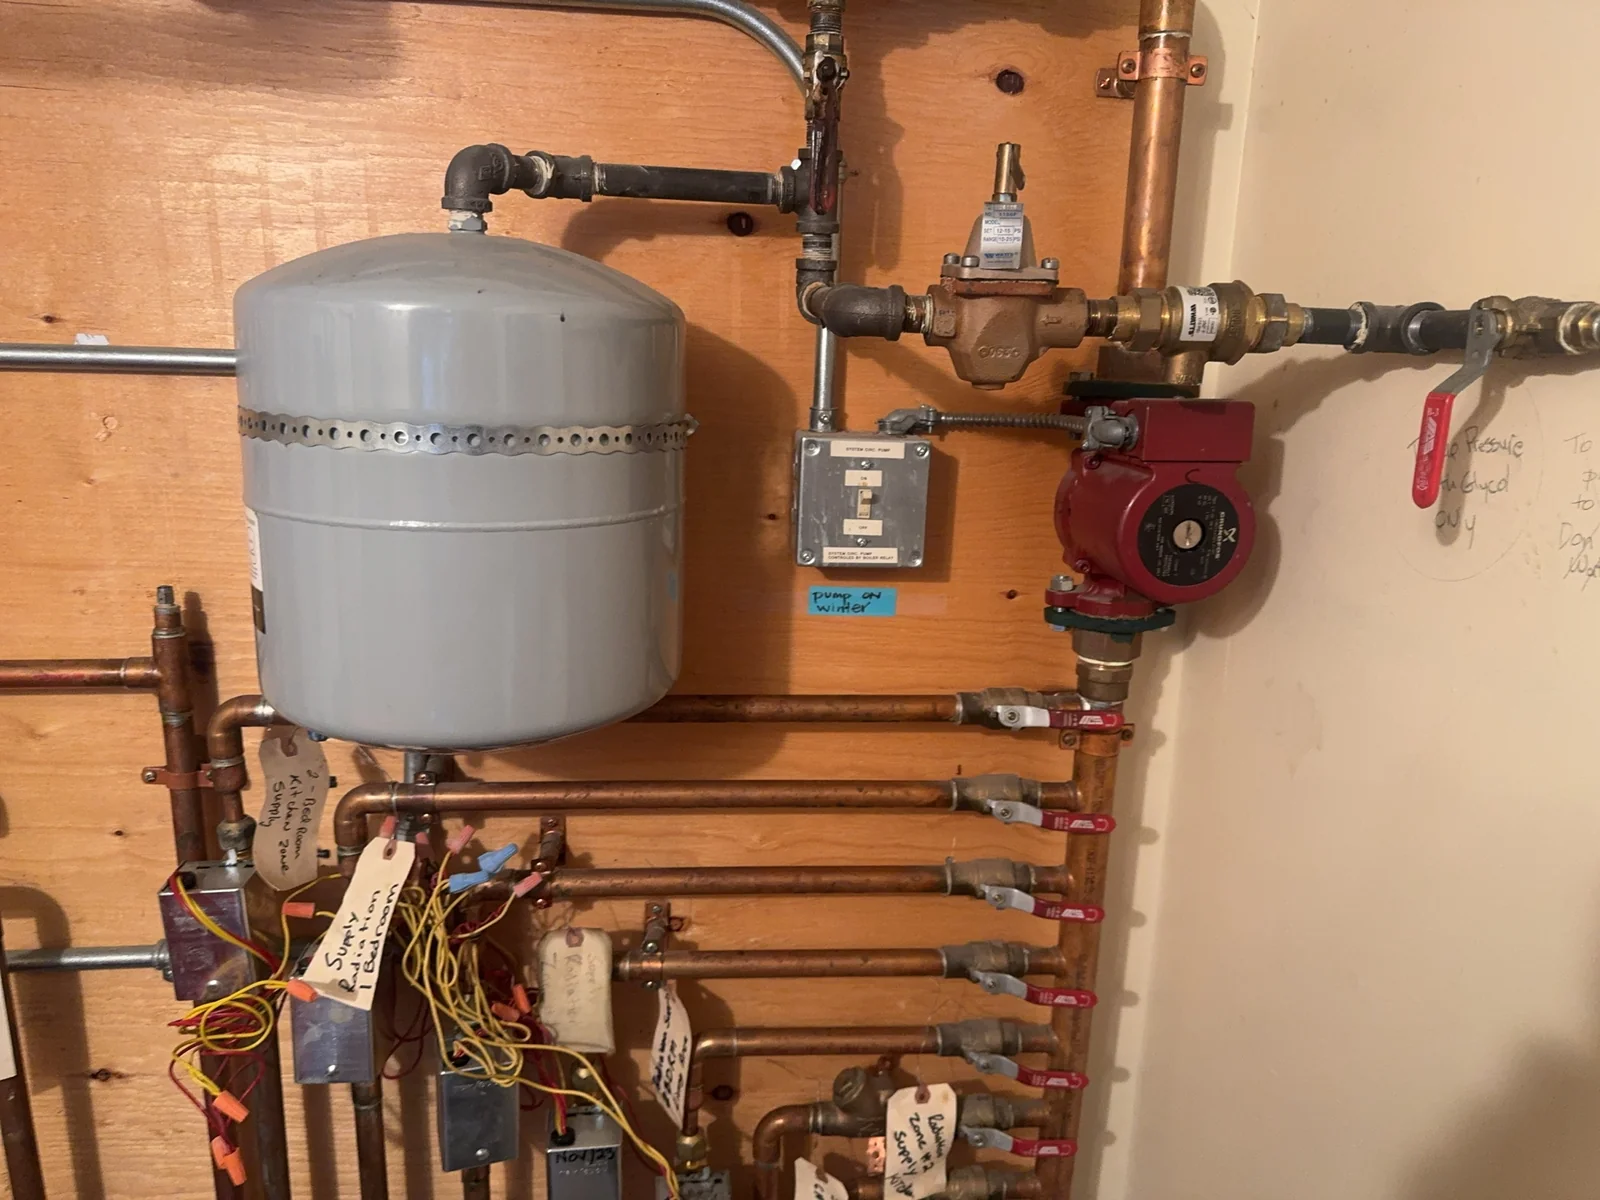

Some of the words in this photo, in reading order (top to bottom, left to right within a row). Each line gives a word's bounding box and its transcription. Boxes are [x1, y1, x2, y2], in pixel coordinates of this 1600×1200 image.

[812, 591, 852, 604] pump
[816, 601, 872, 614] winter
[894, 1129, 918, 1176] Supply
